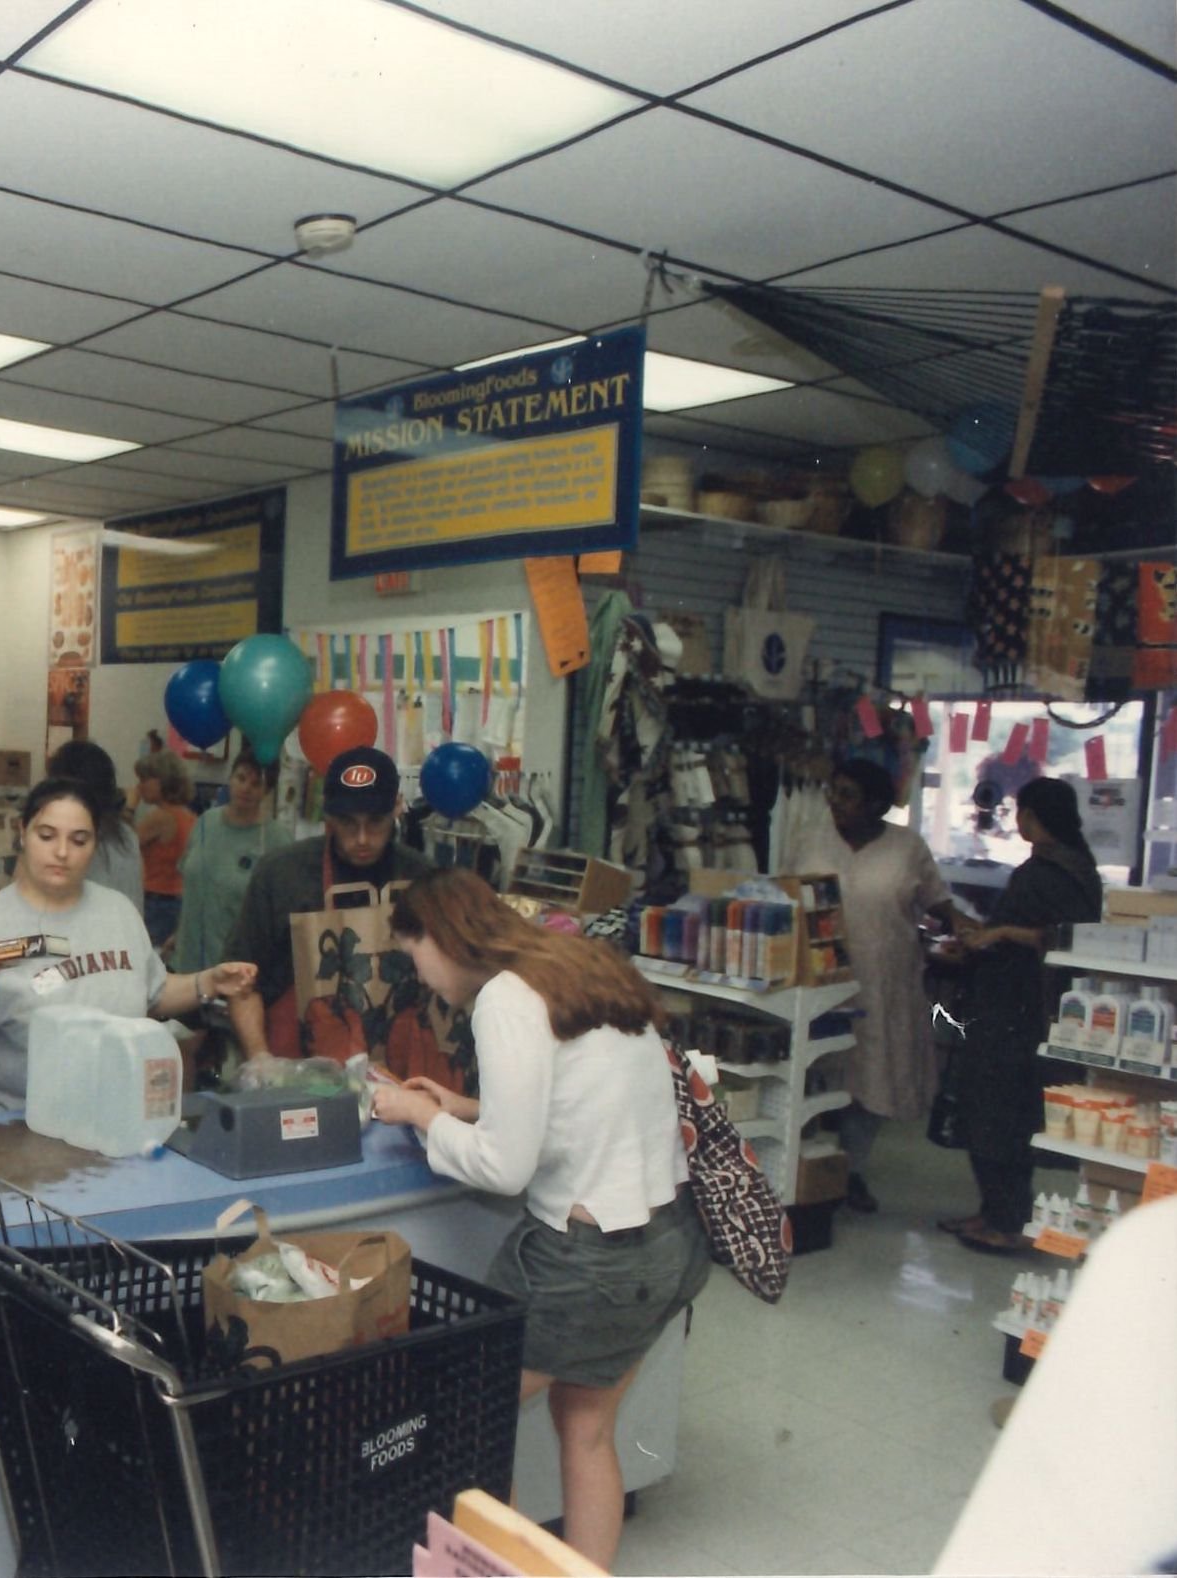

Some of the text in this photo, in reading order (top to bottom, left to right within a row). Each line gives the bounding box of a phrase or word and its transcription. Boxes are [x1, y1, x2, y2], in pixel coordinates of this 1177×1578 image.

[344, 373, 630, 460] MISSION STATEMENT
[33, 950, 133, 982] DIANA
[361, 1414, 427, 1458] BLOOMING
[371, 1437, 415, 1472] FOODS
